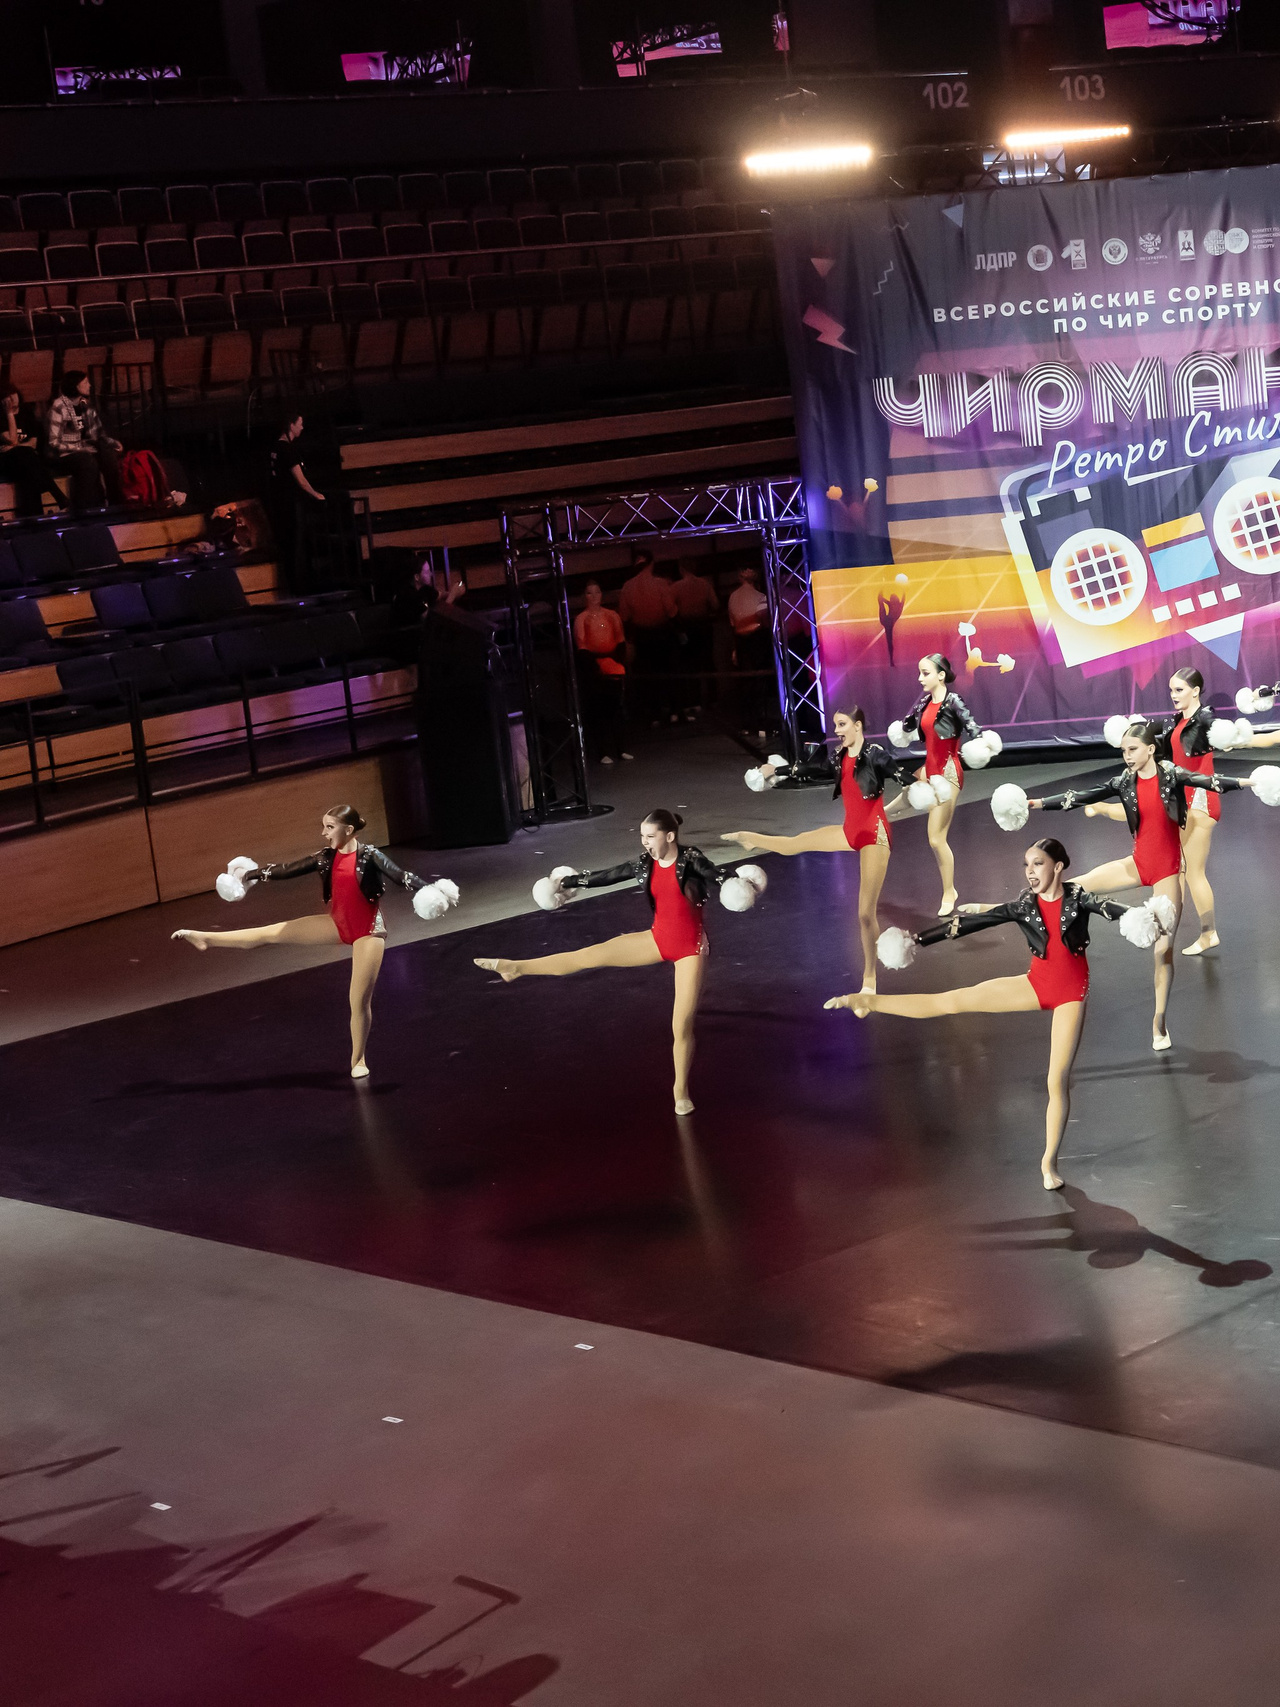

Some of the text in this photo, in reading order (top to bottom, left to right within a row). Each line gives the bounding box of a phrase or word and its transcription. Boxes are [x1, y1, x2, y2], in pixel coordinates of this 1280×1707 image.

[922, 81, 969, 109] 102
[1059, 74, 1106, 101] 103
[974, 251, 1018, 272] ЛДПР
[933, 290, 1156, 323] ВСЕРОССИЙСКИЕ
[1053, 301, 1262, 333] ПО ЧИР СПОРТУ
[1048, 438, 1167, 488] Ретро
